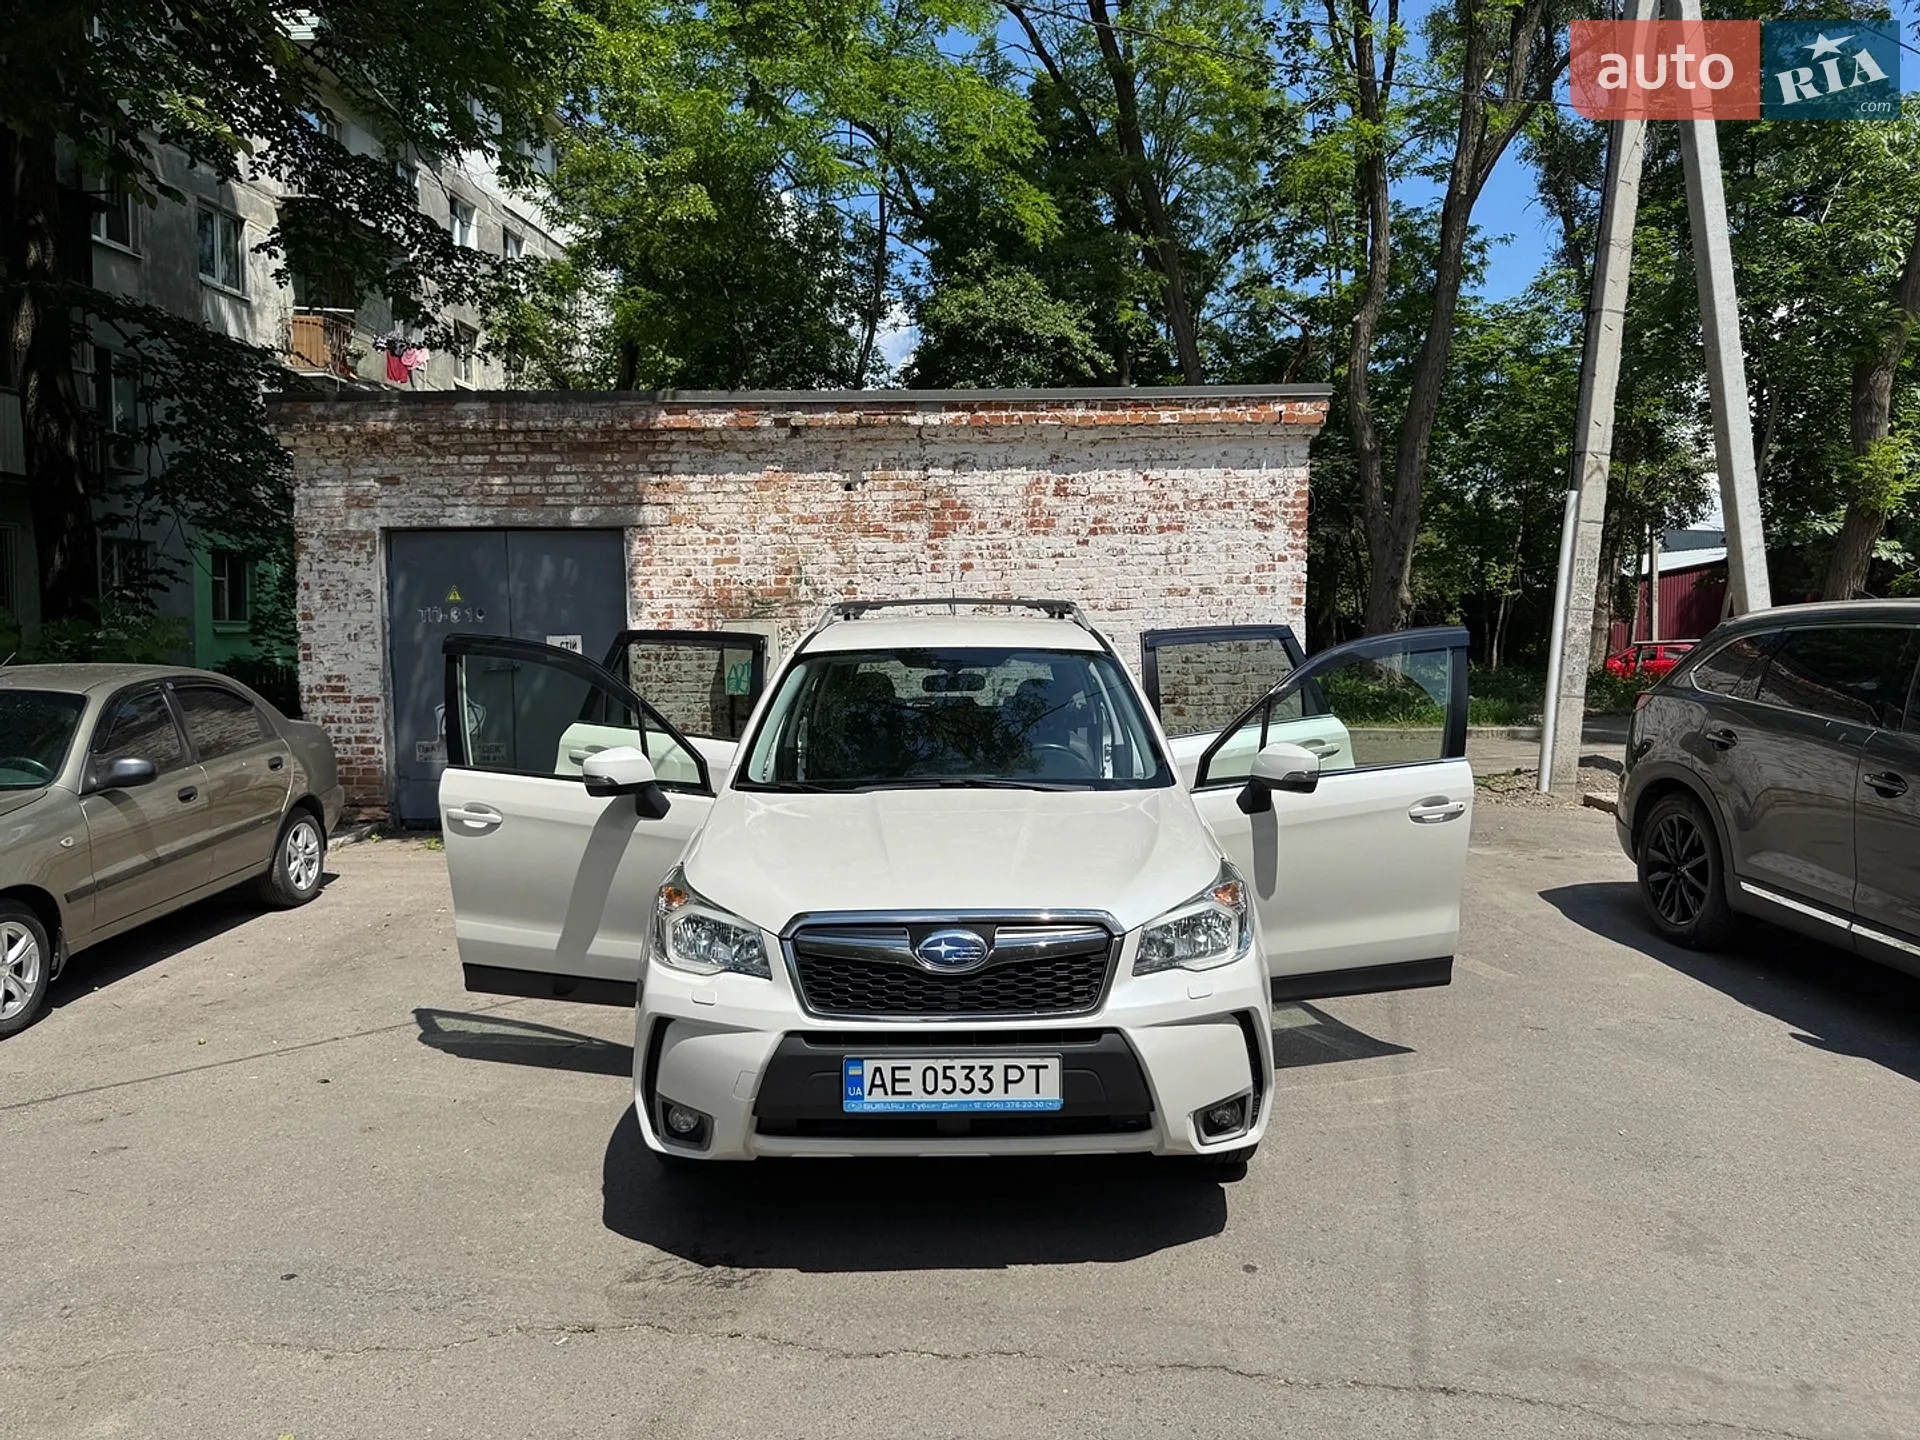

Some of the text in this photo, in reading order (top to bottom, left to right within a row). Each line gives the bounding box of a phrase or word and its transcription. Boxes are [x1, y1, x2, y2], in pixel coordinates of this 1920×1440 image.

[867, 1065, 1049, 1096] AE 0533 PT
[848, 1087, 862, 1096] UA
